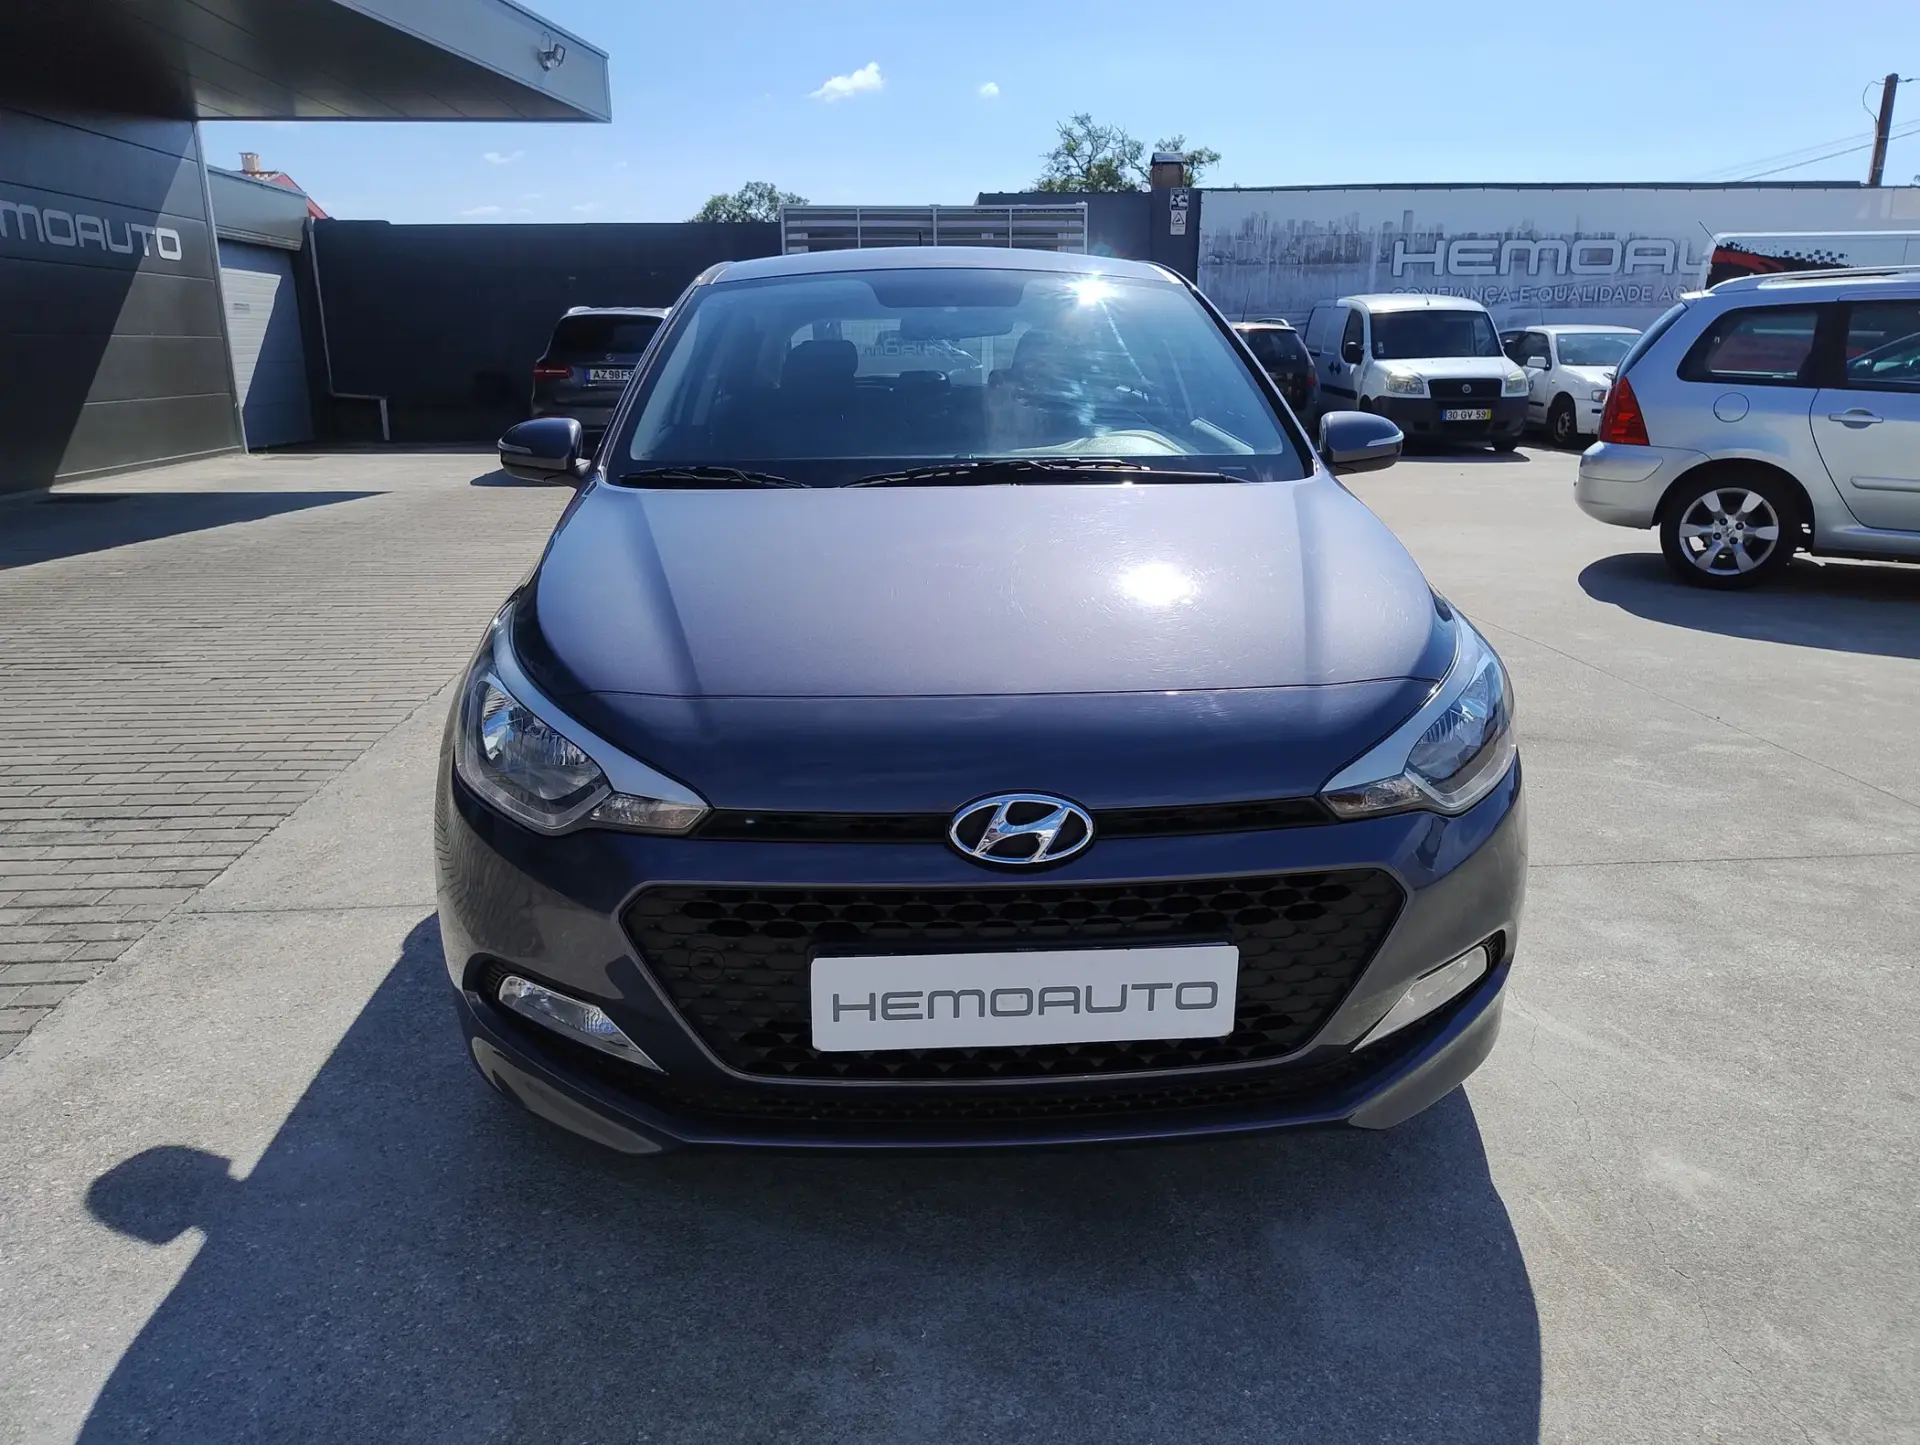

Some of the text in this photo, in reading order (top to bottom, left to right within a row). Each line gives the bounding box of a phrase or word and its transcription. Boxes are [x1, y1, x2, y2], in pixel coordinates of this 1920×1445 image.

[1519, 286, 1533, 303] E
[1538, 285, 1654, 303] QUALIDADE
[831, 981, 1219, 1023] HEMOAUTO
